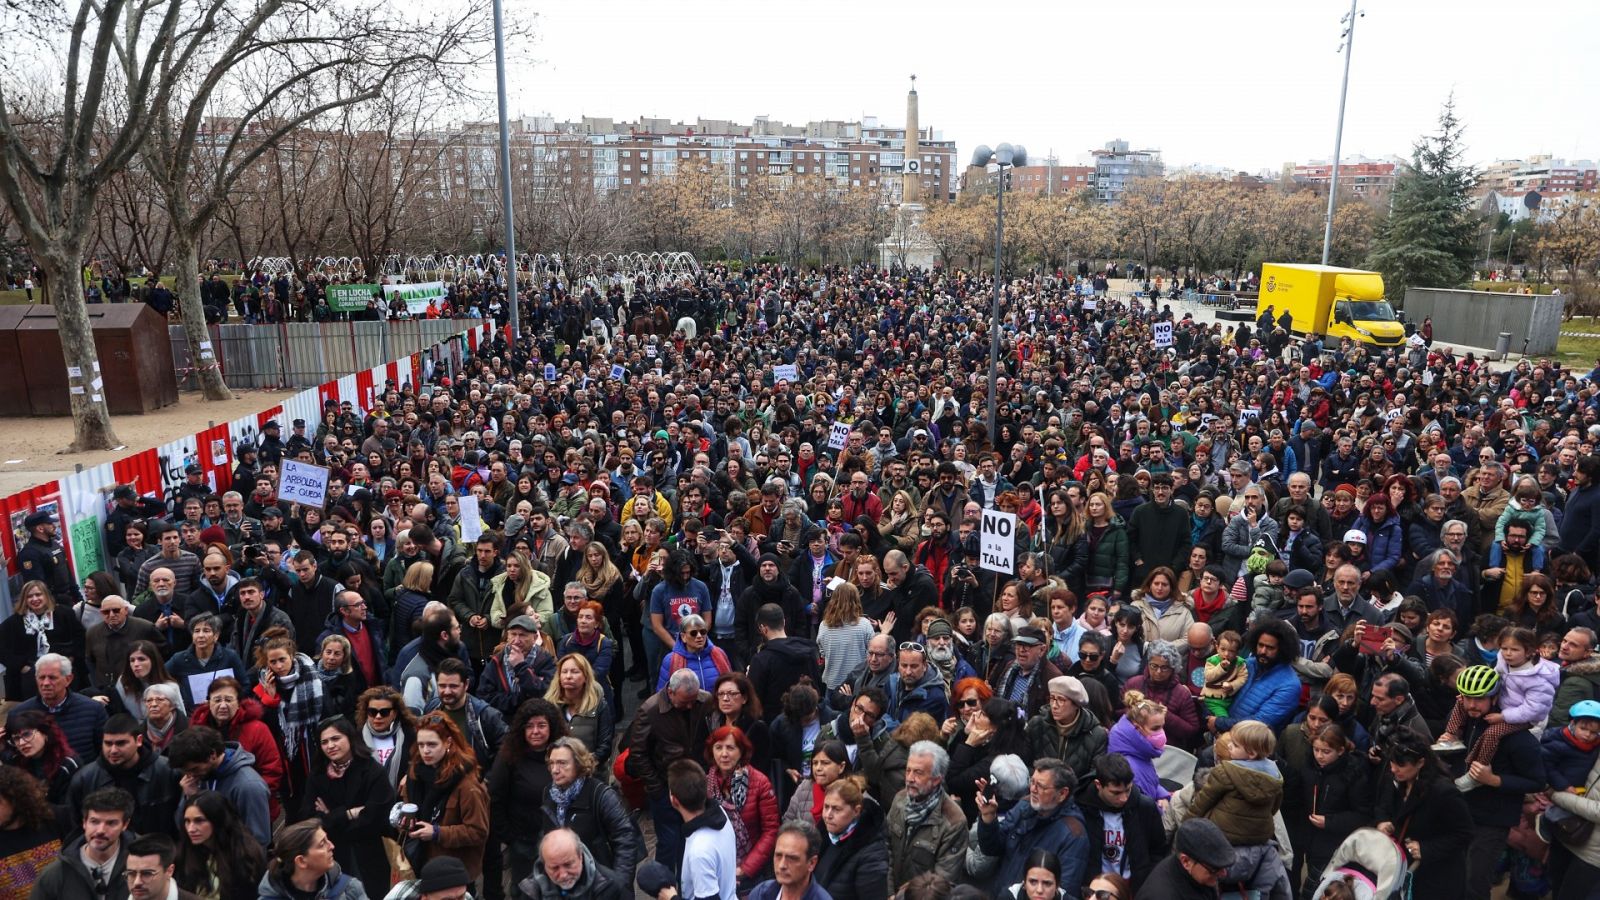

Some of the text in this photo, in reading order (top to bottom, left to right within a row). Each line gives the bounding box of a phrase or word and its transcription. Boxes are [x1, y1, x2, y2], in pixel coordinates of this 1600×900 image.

[349, 288, 372, 297] LUCHA
[1156, 325, 1171, 333] NO
[1242, 412, 1256, 420] NO
[833, 425, 849, 436] NO
[285, 462, 297, 472] LA
[284, 474, 323, 490] ARBOLEDA
[284, 485, 322, 500] SE QUEDA
[983, 514, 1011, 538] NO
[995, 543, 1002, 552] la
[982, 553, 1010, 569] TALA
